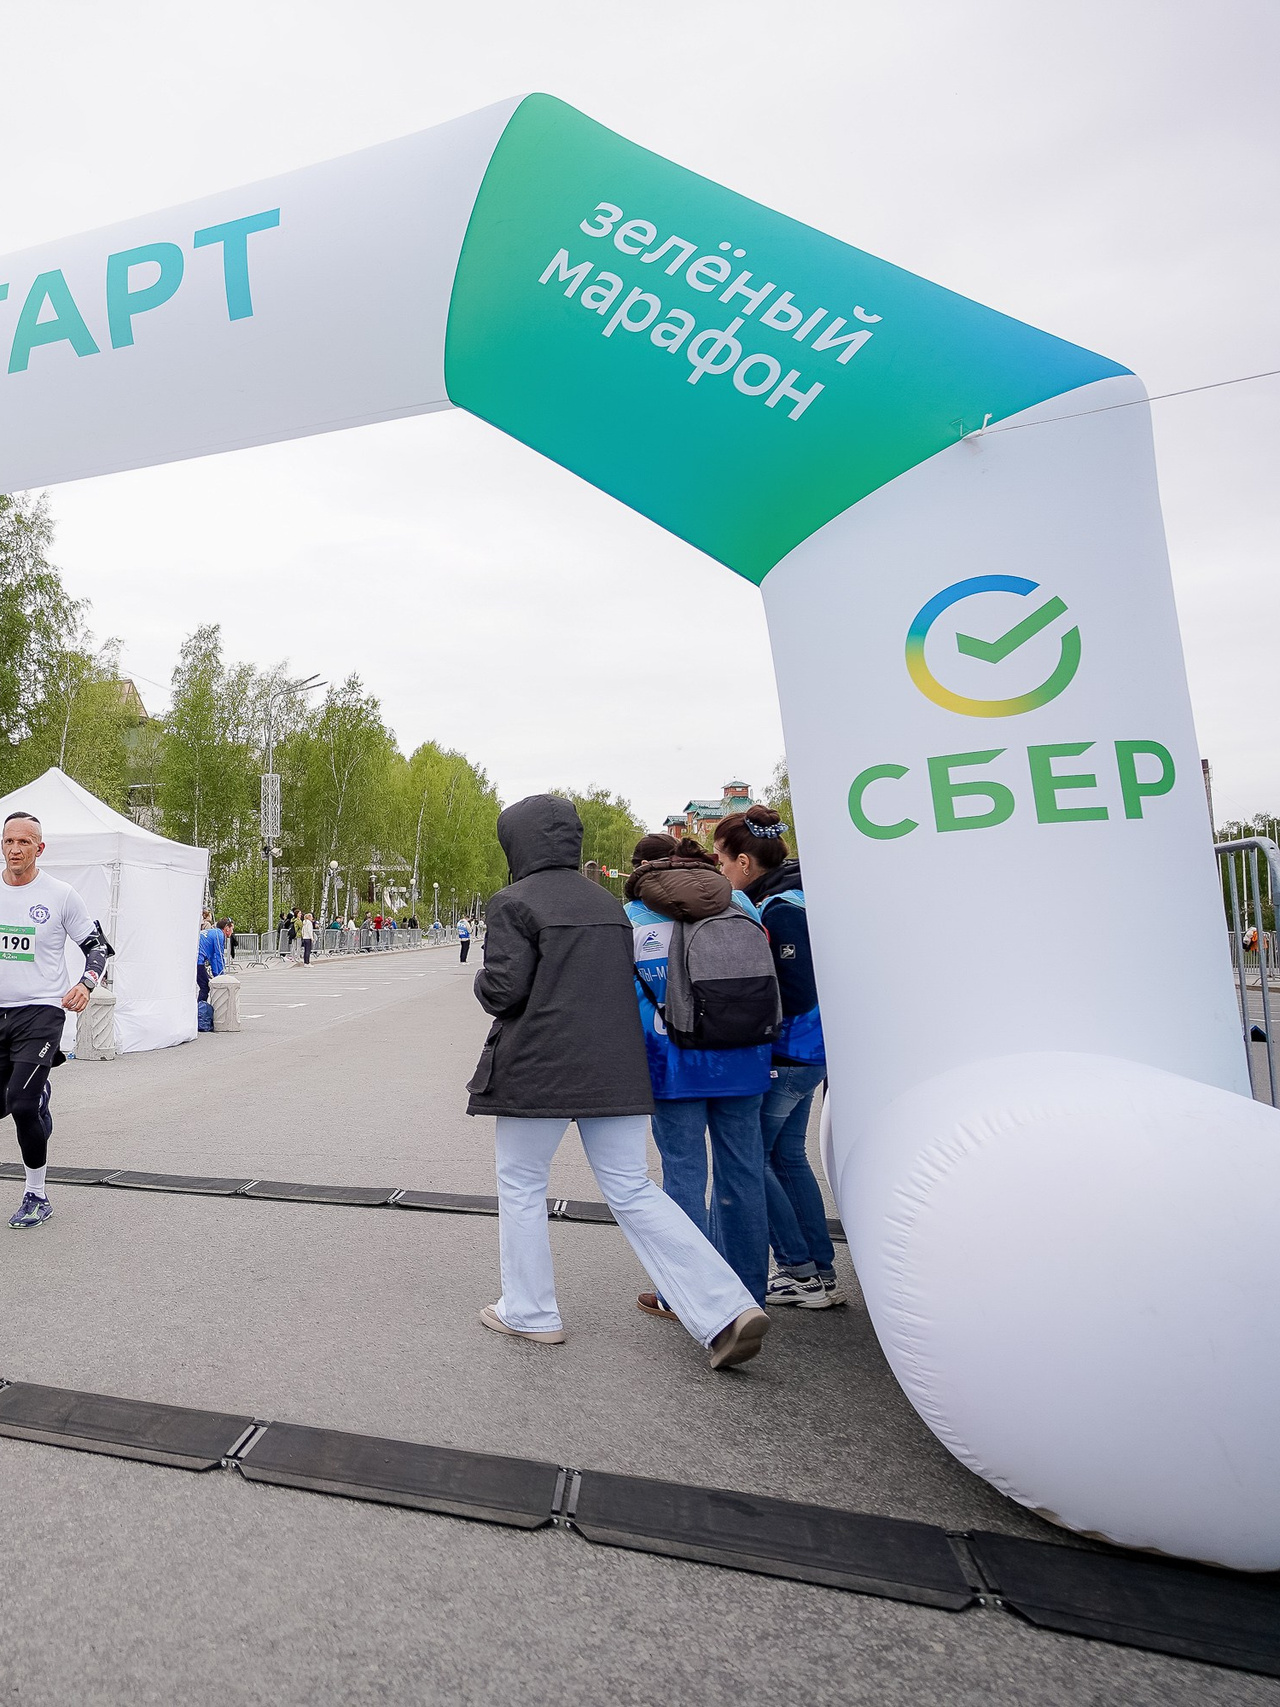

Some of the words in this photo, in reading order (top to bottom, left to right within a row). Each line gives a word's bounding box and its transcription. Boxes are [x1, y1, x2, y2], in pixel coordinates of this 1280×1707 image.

[537, 247, 826, 422] марафон
[578, 200, 884, 366] зелёный
[847, 739, 1176, 840] СБЕР
